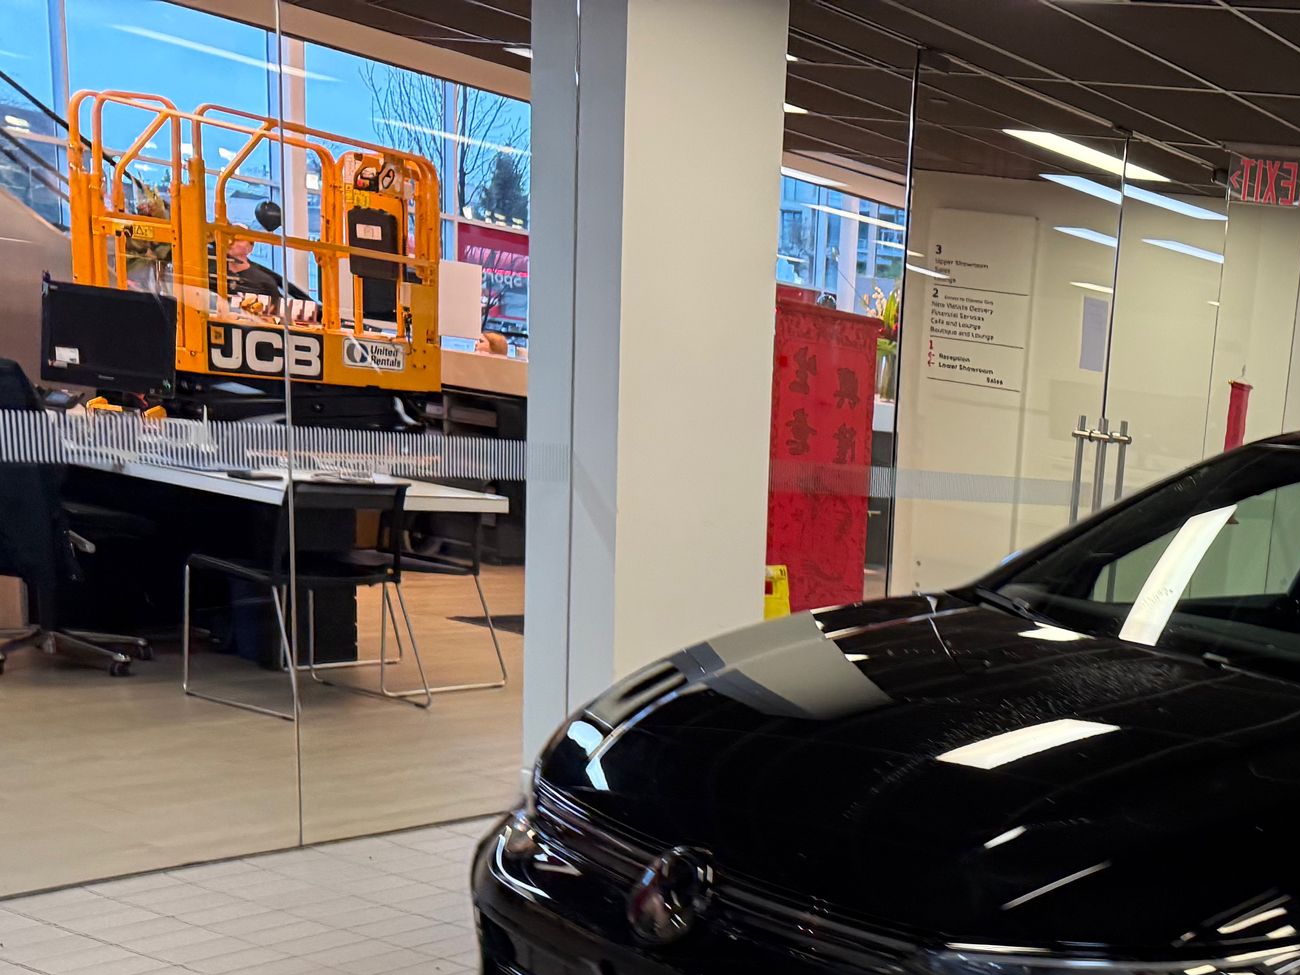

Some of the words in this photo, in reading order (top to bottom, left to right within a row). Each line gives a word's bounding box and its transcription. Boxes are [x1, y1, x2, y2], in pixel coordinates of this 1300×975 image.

[935, 244, 942, 255] 3
[932, 287, 939, 298] 2
[210, 328, 321, 376] JCB
[370, 345, 398, 358] United
[371, 355, 401, 368] Rentals
